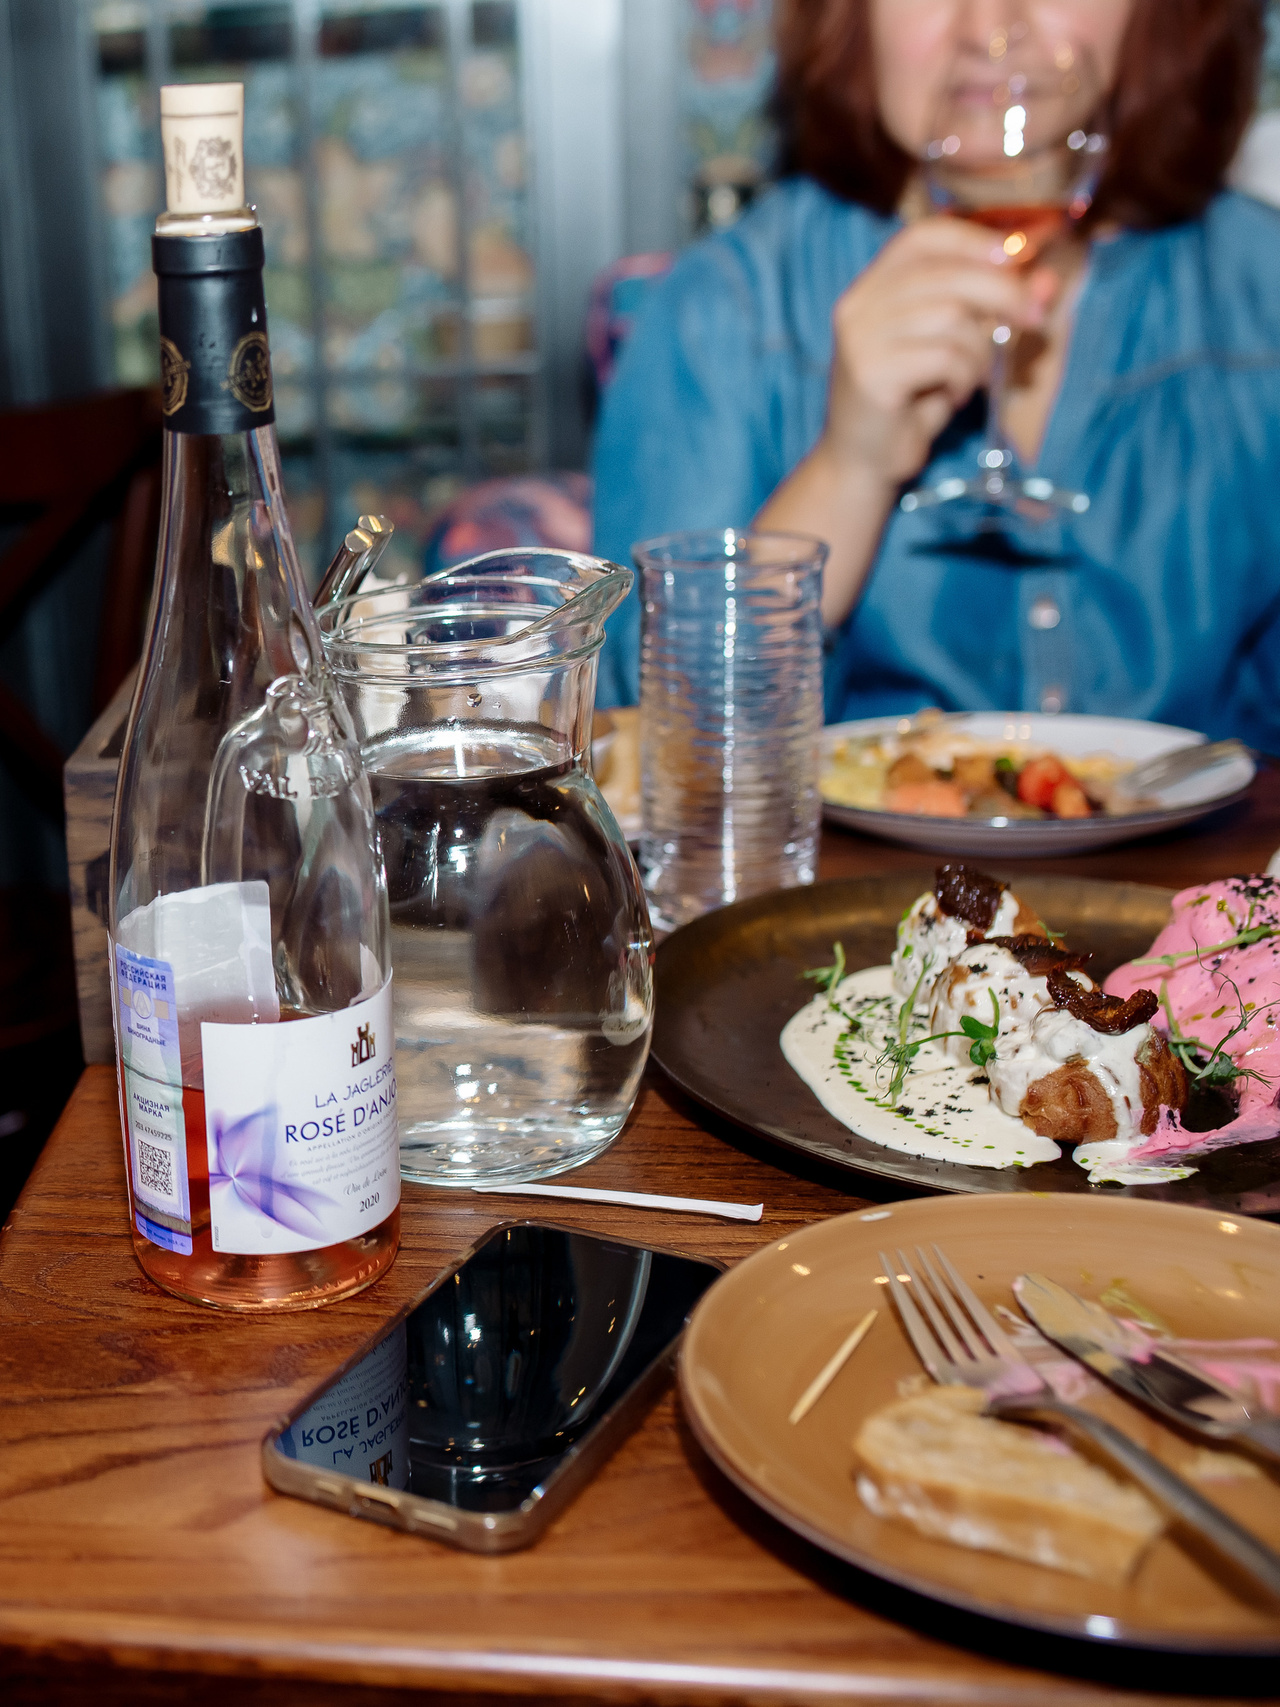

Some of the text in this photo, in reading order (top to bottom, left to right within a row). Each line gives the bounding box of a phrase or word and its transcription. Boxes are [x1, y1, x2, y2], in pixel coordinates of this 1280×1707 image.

[120, 960, 167, 983] РОССИЙСКАЯ
[120, 968, 167, 991] ФЕДЕРАЦИЯ
[127, 1026, 167, 1047] ВИНОГРАДНЫЕ
[136, 1022, 152, 1034] ВИНА
[133, 1092, 170, 1112] АКЦИЗНАЯ
[285, 1077, 397, 1143] ROSÉ D'ANJO
[314, 1091, 338, 1109] LA
[138, 1102, 163, 1119] МАРКА
[307, 1133, 357, 1152] APPELLATION
[359, 1192, 381, 1213] 2020
